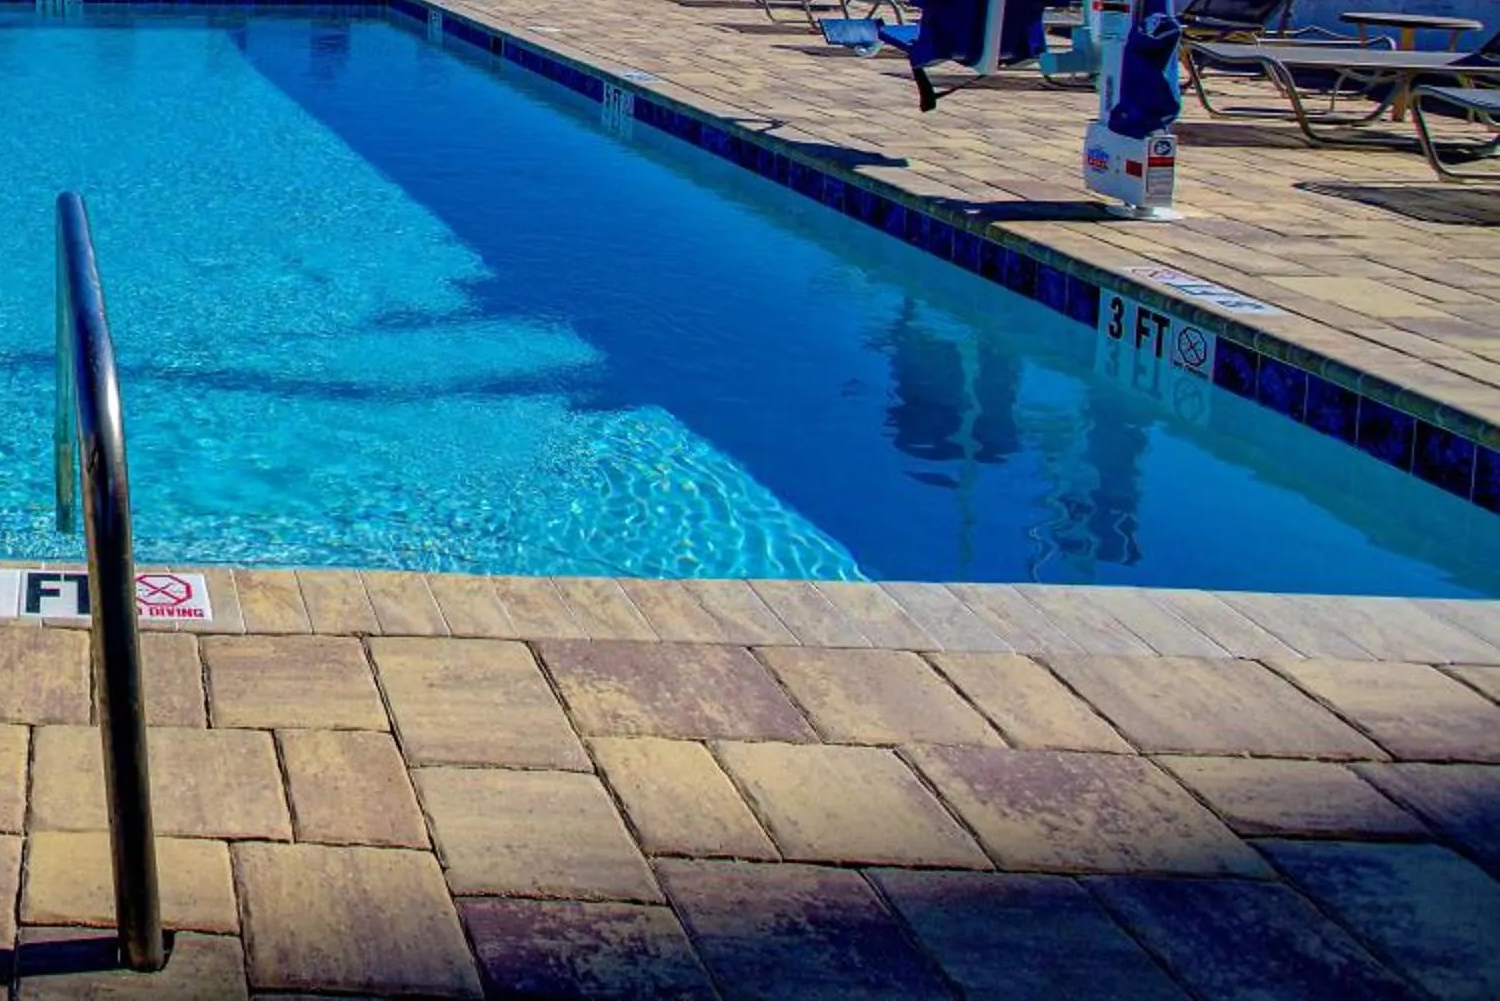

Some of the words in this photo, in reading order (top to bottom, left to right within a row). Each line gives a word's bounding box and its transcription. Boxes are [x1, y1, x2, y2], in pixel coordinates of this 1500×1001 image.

[1108, 297, 1124, 339] 3
[1135, 306, 1171, 358] FT
[149, 607, 205, 618] DIVING
